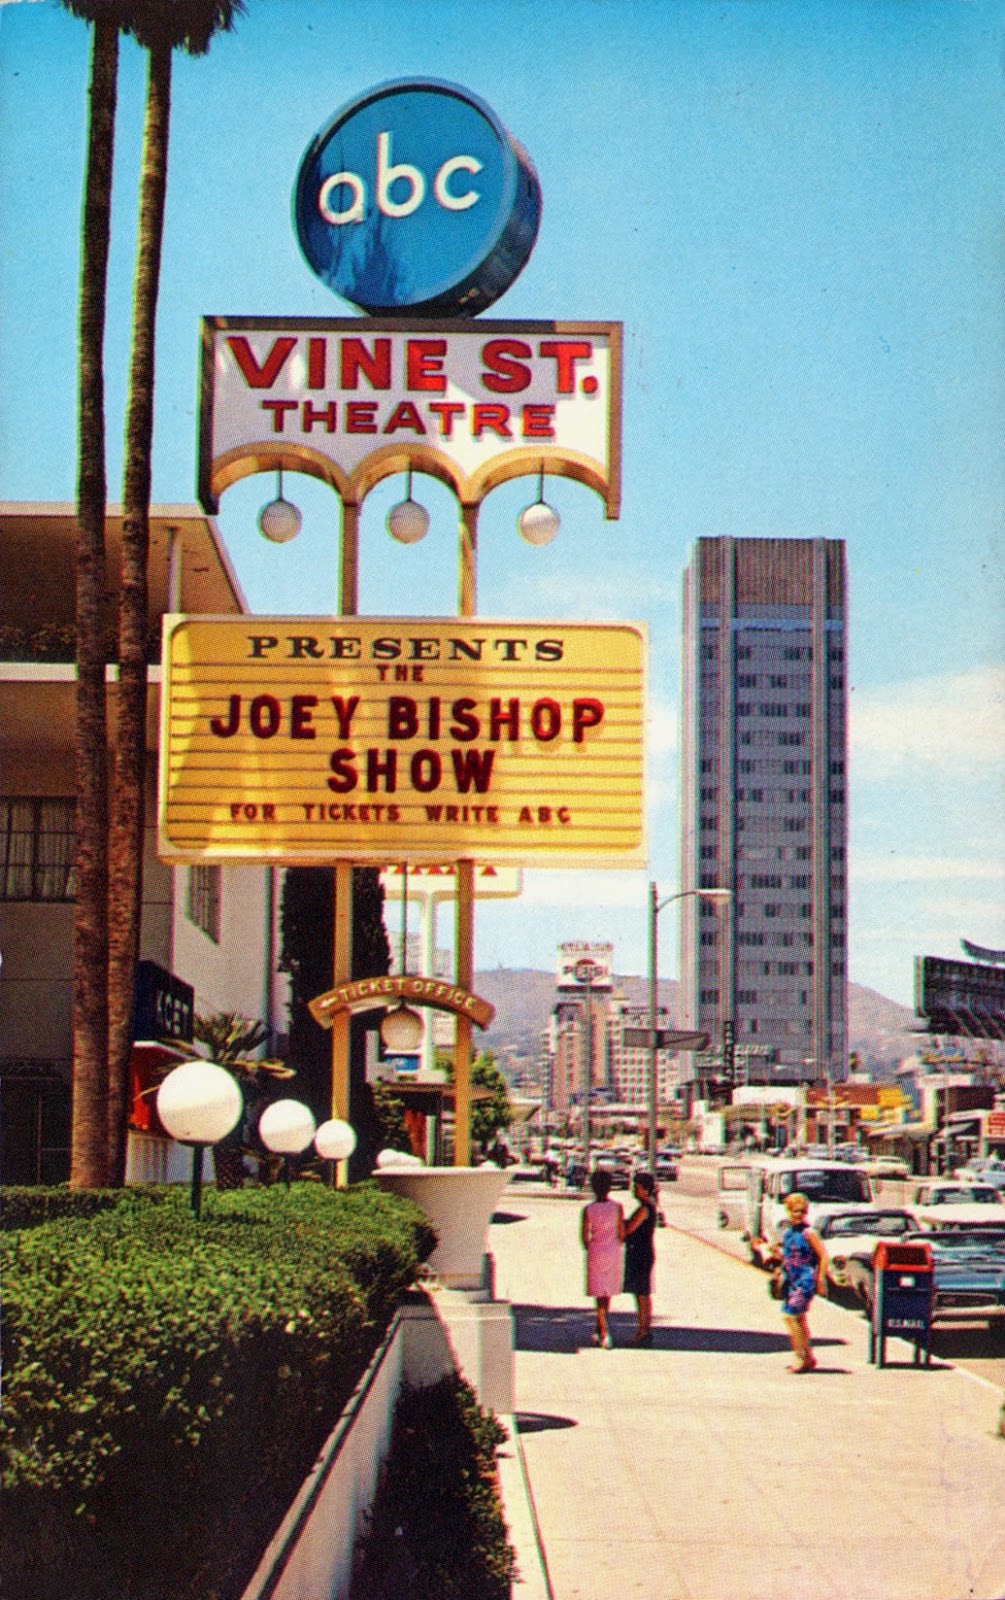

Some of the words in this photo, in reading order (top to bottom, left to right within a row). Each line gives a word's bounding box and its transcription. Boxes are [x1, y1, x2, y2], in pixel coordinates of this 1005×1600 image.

[319, 131, 483, 225] abc
[226, 336, 447, 391] VINE
[481, 340, 599, 395] ST.
[261, 400, 556, 437] THEATRE
[247, 635, 565, 662] PRESENTS
[376, 664, 424, 683] THE
[210, 694, 361, 740] JOEY
[387, 695, 605, 743] BISHOP
[326, 748, 497, 794] SHOW
[230, 803, 277, 821] FOR
[303, 804, 401, 822] TICKETS
[425, 805, 499, 823] WRITE
[518, 806, 571, 824] ABC
[339, 977, 405, 1001] TICKET
[411, 979, 478, 1010] OFFICE
